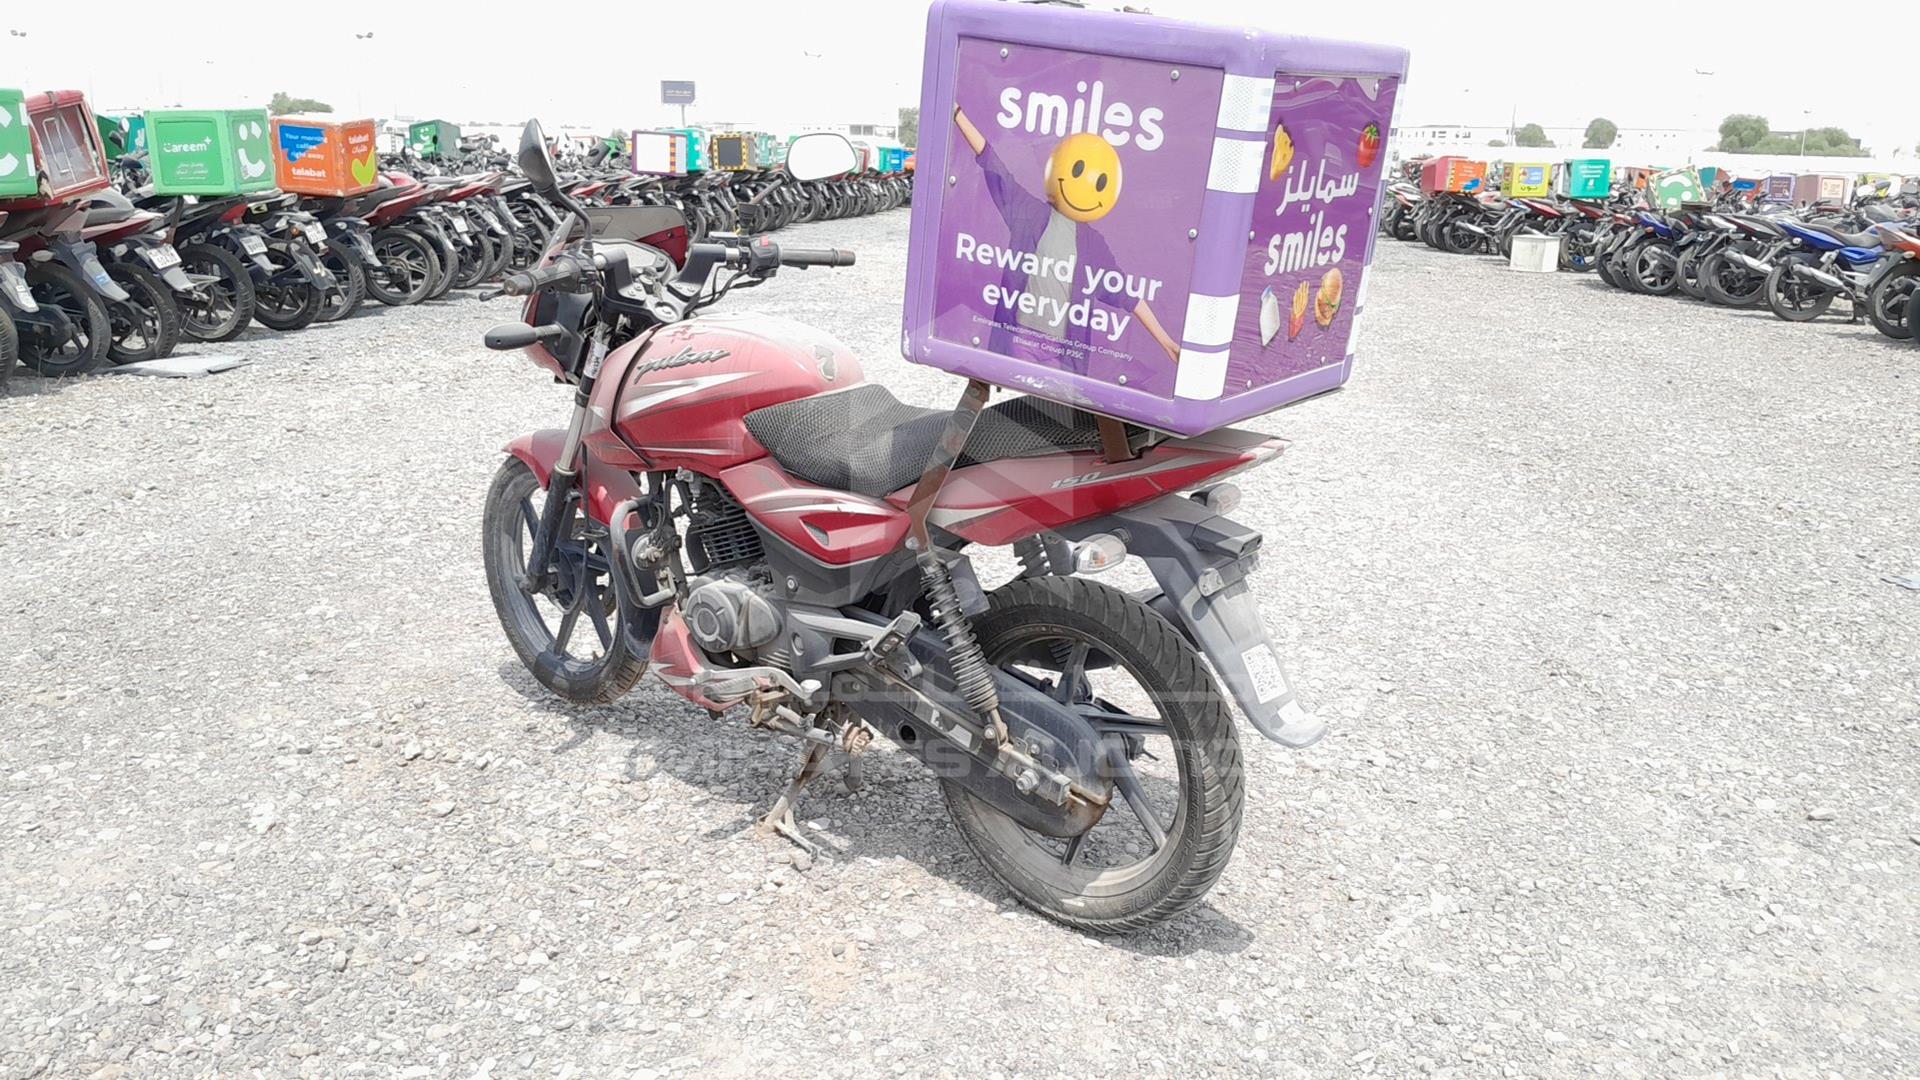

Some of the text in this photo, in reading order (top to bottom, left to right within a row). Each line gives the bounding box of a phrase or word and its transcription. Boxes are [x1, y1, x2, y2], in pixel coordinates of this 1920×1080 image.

[997, 80, 1164, 151] smiles
[291, 167, 327, 178] talabat
[1275, 158, 1360, 217] سمايلز
[955, 232, 1163, 302] Reward your
[1264, 210, 1348, 276] smiles
[972, 314, 1002, 329] Emirates
[1074, 339, 1097, 353] Group
[1097, 346, 1133, 362] Company
[982, 283, 1131, 342] everyday
[1050, 471, 1101, 489] 150
